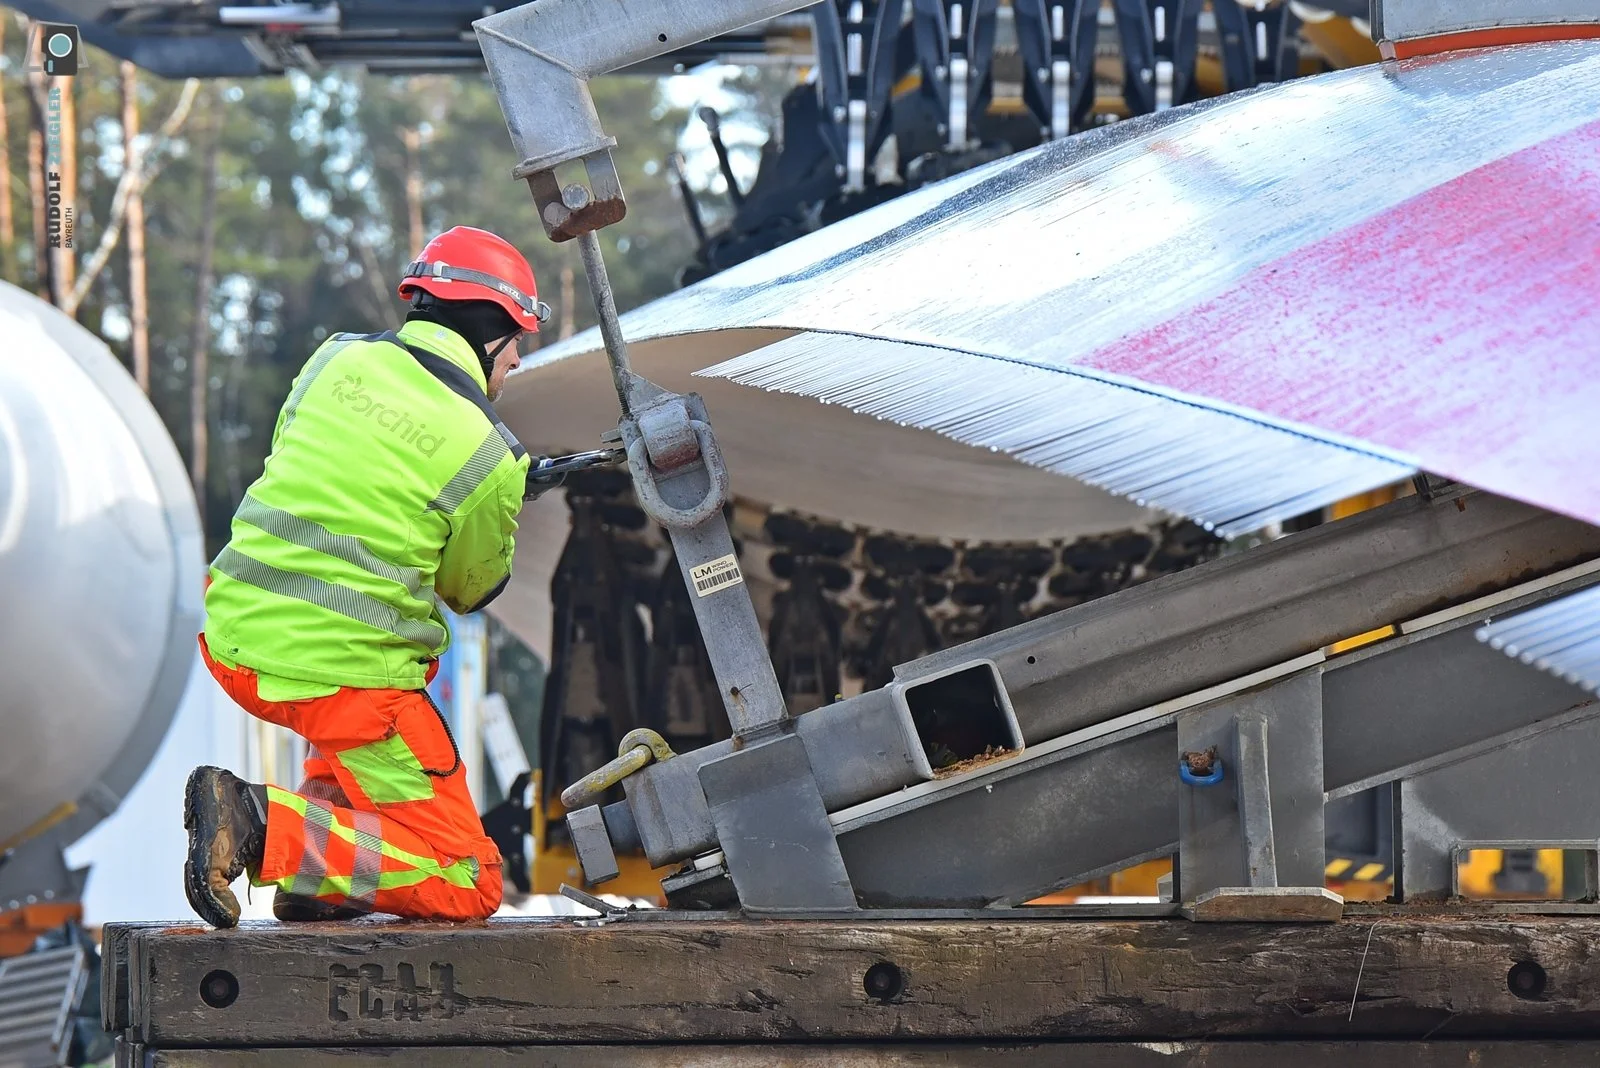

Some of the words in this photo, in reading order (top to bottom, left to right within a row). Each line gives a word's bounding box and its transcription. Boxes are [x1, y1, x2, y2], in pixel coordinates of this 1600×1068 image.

[499, 282, 520, 299] PETZL
[350, 393, 447, 459] orchid
[693, 566, 712, 579] LM
[713, 562, 734, 572] POWER
